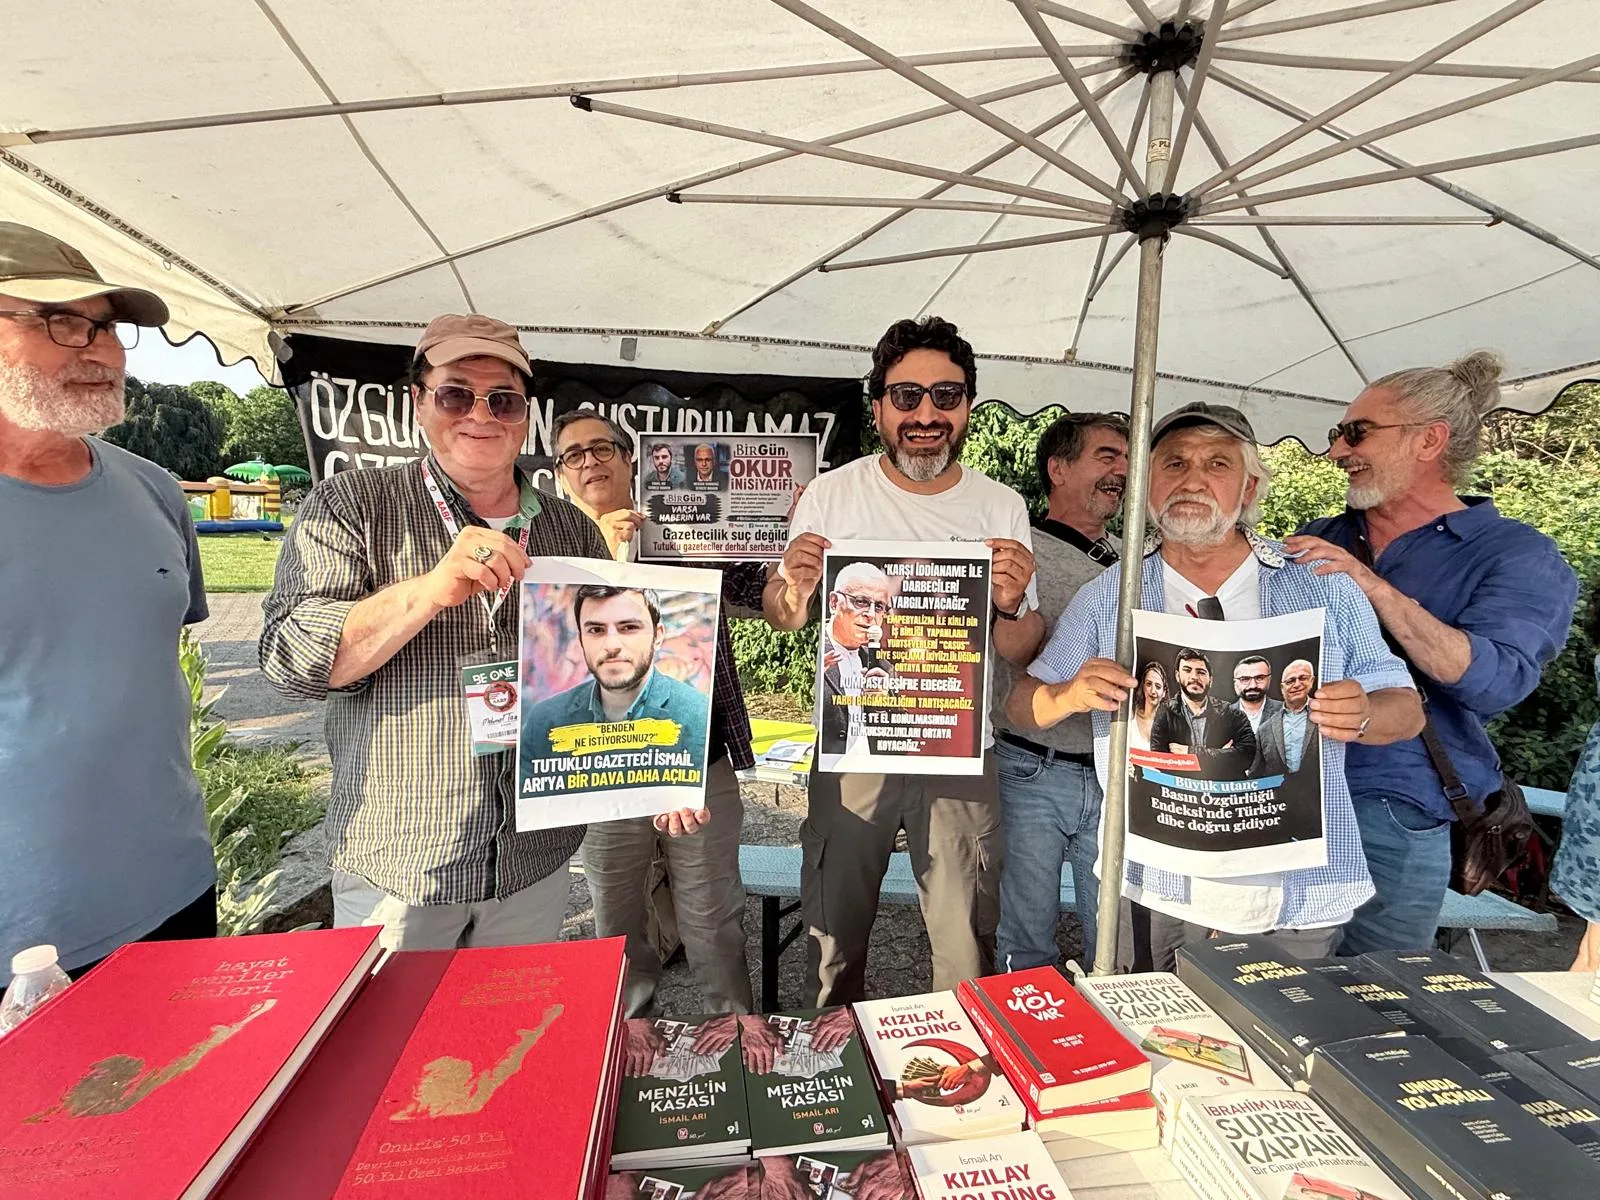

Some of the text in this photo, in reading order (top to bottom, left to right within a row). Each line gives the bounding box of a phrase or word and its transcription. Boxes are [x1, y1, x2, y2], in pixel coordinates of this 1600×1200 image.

[730, 459, 793, 478] OKUR
[436, 500, 453, 523] AABF
[671, 505, 698, 514] VARSA
[696, 513, 711, 522] VAR
[662, 528, 728, 541] Gazetecilik
[731, 531, 752, 543] suç
[653, 541, 681, 551] Tutuklu
[683, 542, 723, 553] gazeteciler
[725, 542, 748, 552] derhal
[749, 542, 776, 552] serbest
[915, 562, 967, 577] İDDİANAME
[968, 563, 983, 578] İLE
[902, 579, 960, 594] DARBECİLERİ
[876, 649, 891, 660] DİYE
[472, 667, 515, 685] BE ONE
[882, 711, 889, 724] EL
[574, 738, 587, 748] NE
[922, 728, 952, 739] ORTAYA
[532, 749, 694, 774] TUTUKLU GAZETECİ İSMAİL
[523, 768, 700, 793] ARI'YA BİR DAVA DAHA AÇILDI
[1175, 776, 1259, 792] Büyük utanç
[1161, 786, 1275, 808] Basın Özgürlüğü
[1151, 796, 1287, 819] Endeksi'nde Türkiye
[1156, 812, 1281, 834] dibe doğru gidiyor
[1233, 973, 1264, 986] YOL
[1261, 966, 1309, 981] AÇMALI
[1236, 960, 1285, 975] UMUDA
[1090, 977, 1177, 991] İBRAHİM VARLI
[1421, 981, 1496, 995] YOL AÇMALI
[1423, 974, 1472, 984] UMUDA
[1011, 983, 1040, 997] BİR
[1099, 985, 1191, 1005] SURİYE
[1006, 991, 1066, 1014] YOL
[1109, 998, 1206, 1020] KAPANI
[878, 1009, 945, 1027] KIZILAY
[1030, 1007, 1066, 1022] VAR
[876, 1021, 962, 1040] HOLDİNG
[638, 1080, 728, 1103] MENZİL'İN
[766, 1075, 854, 1099] MENZİL'İN
[1398, 1077, 1463, 1096] UMUDA
[650, 1094, 716, 1113] KASASI
[780, 1088, 845, 1109] KASASI
[1201, 1098, 1314, 1117] İBRAHİM VARLI
[1396, 1089, 1496, 1112] YOL AÇMALI
[659, 1112, 707, 1125] İSMAİL ARI
[792, 1106, 840, 1120] İSMAİL ARI
[1215, 1111, 1336, 1140] SURİYE
[1230, 1134, 1360, 1165] KAPANI
[1251, 1156, 1371, 1176] Bir Cinayetin Anatomisi
[943, 1163, 1031, 1190] KIZILAY
